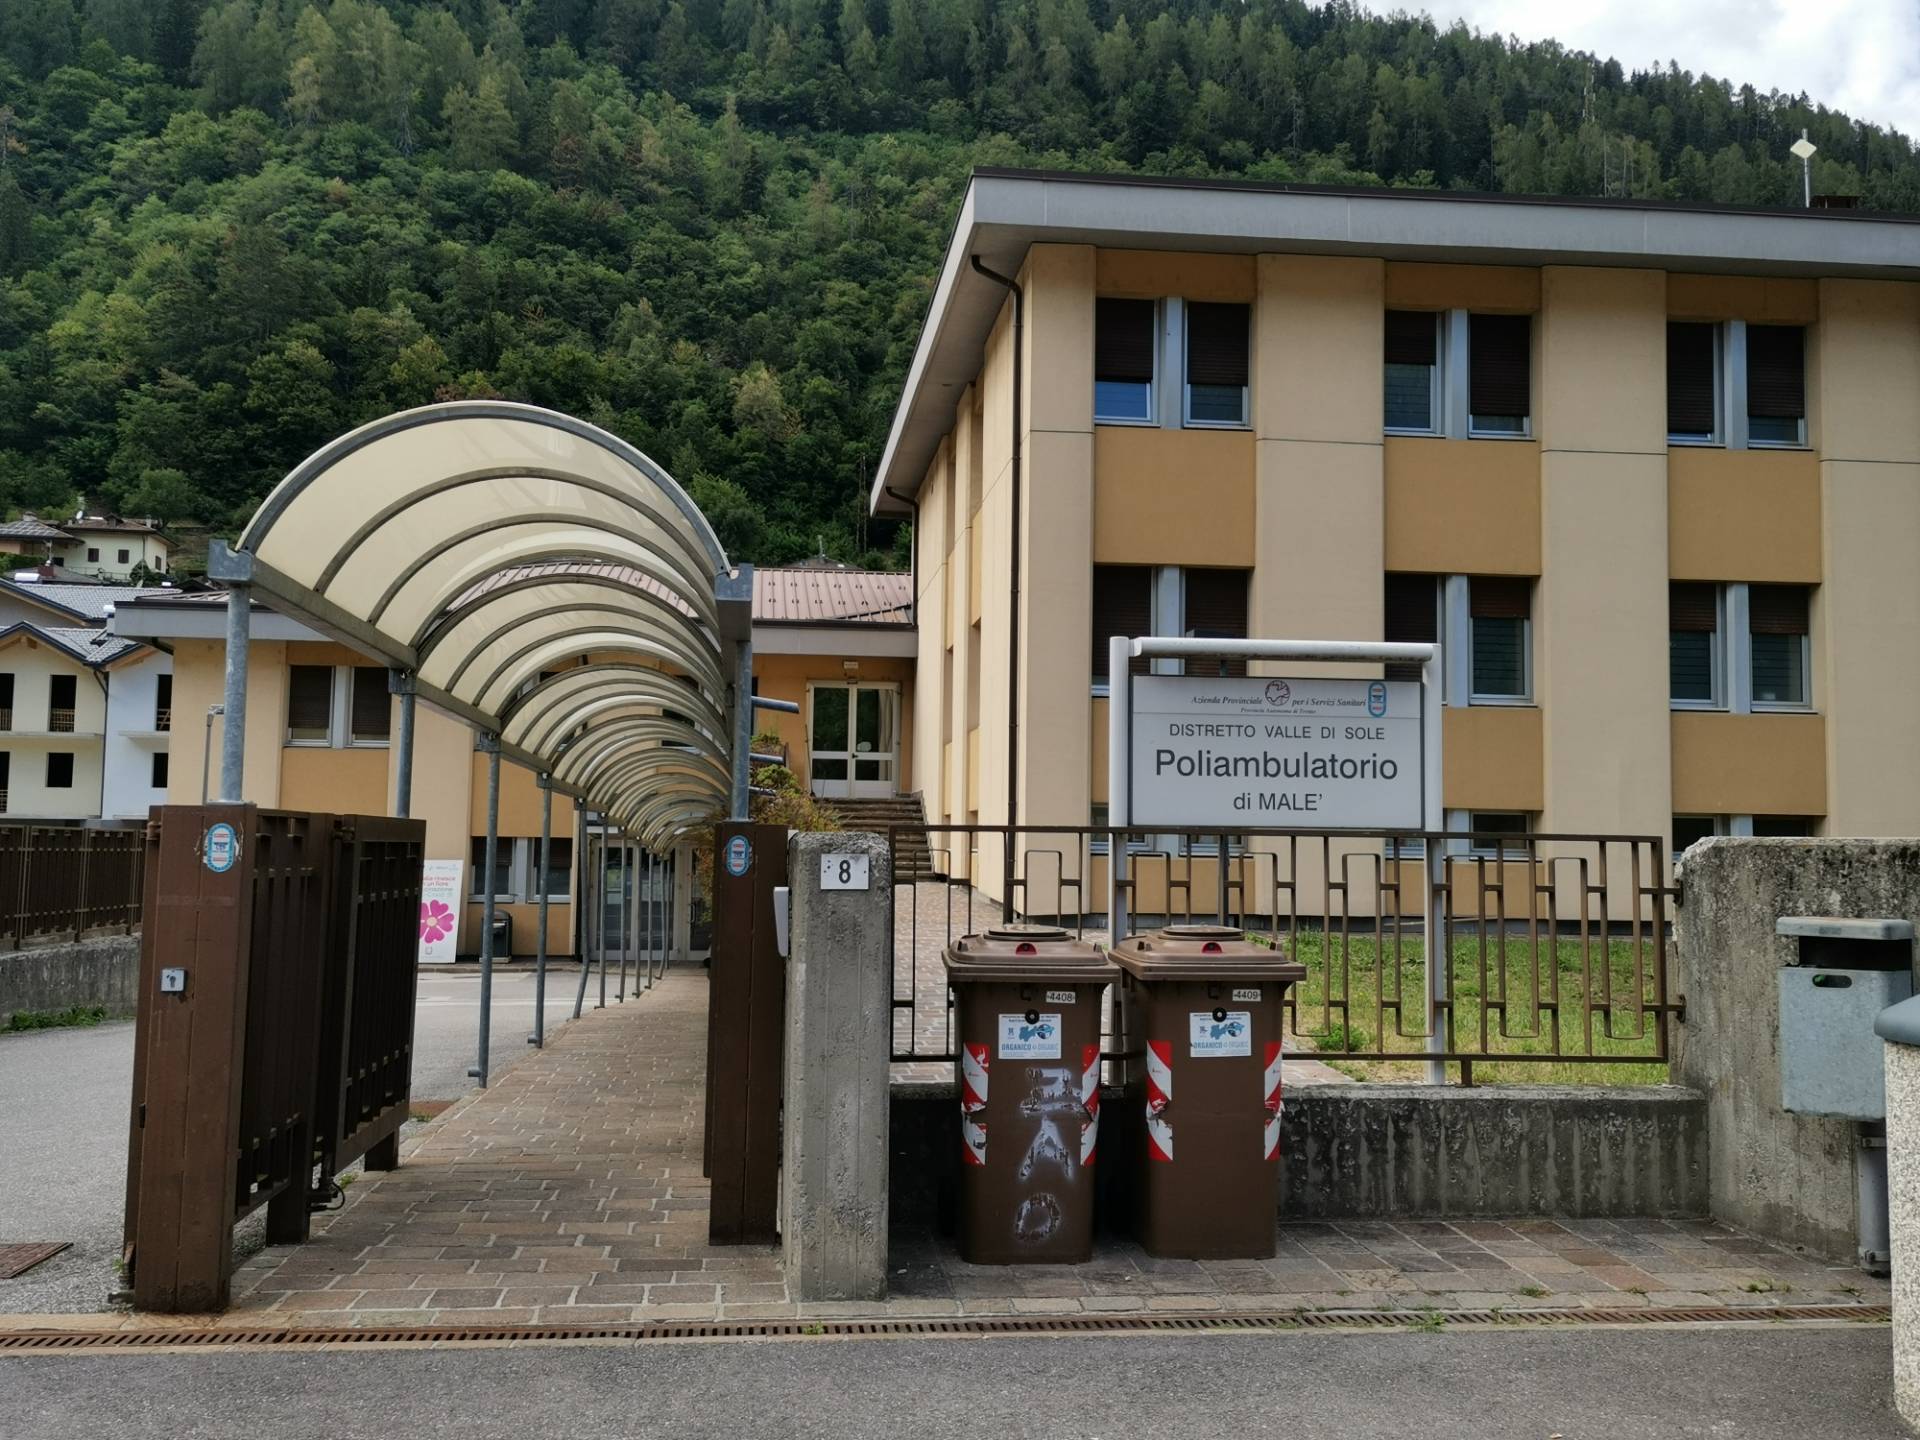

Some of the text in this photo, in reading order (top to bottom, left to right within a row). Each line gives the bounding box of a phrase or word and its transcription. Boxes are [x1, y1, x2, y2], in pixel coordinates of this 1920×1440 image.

[1191, 695, 1221, 705] Azienda
[1222, 695, 1263, 705] Provinciale
[1291, 698, 1304, 707] per
[1311, 697, 1336, 706] Servizi
[1336, 698, 1367, 707] Sanitari
[1169, 723, 1386, 741] DISTRETTO VALLE DI SOLE
[1155, 749, 1398, 780] Poliambulatorio
[1232, 793, 1323, 812] di MALE'
[838, 859, 852, 885] 8
[1050, 992, 1073, 1002] 4408
[1236, 991, 1259, 1000] 4409
[1001, 1043, 1032, 1051] ORGANICO
[1193, 1041, 1223, 1050] ORGANICO
